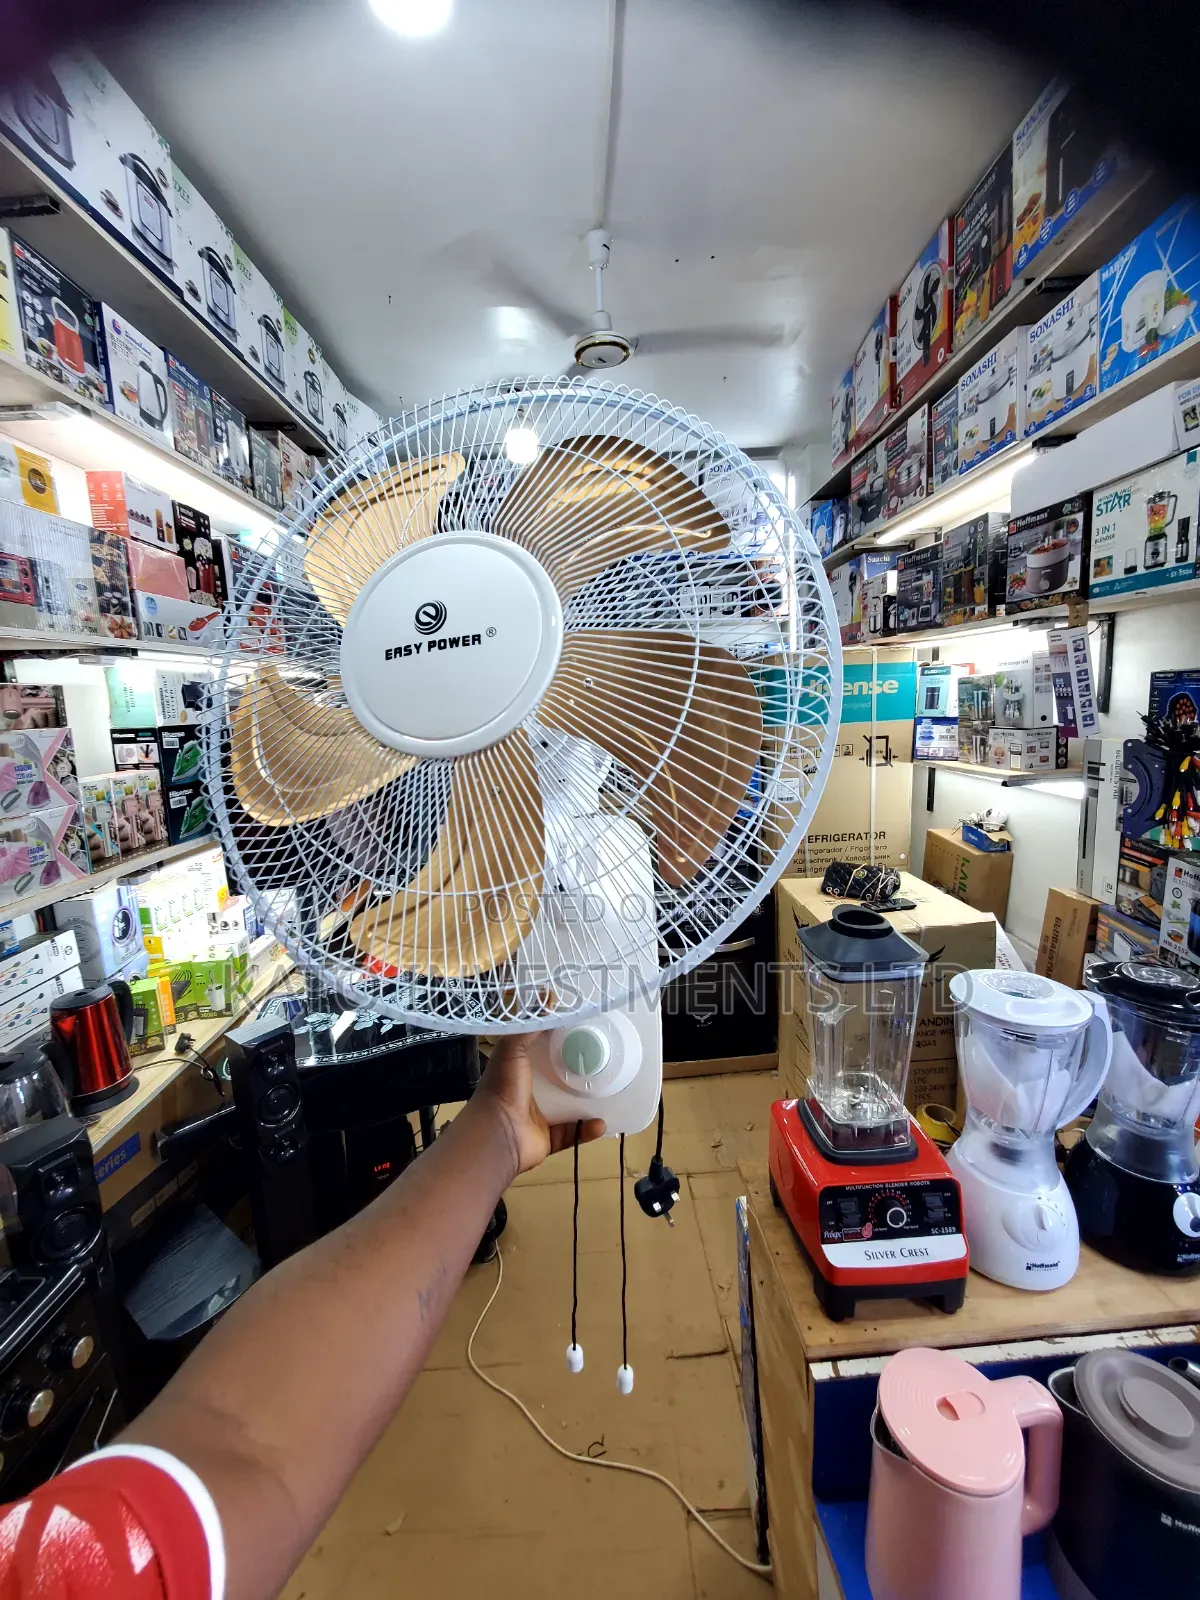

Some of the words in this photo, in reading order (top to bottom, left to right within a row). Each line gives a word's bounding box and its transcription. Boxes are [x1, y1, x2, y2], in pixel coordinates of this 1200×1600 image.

[1029, 296, 1075, 344] SONASHI
[959, 350, 998, 391] SONASHI
[1178, 390, 1192, 402] FOR
[1095, 491, 1132, 518] STAR
[1017, 511, 1048, 528] Hoffmans
[1095, 527, 1100, 537] 3
[1101, 525, 1110, 535] IN
[1094, 533, 1115, 545] BLENDER
[867, 554, 890, 563] Saachi
[385, 642, 423, 661] EASY
[427, 634, 482, 652] POWER
[169, 788, 194, 797] Hisense
[930, 1226, 957, 1235] SC-1589
[864, 1249, 896, 1261] SILVER
[899, 1247, 930, 1258] CREST
